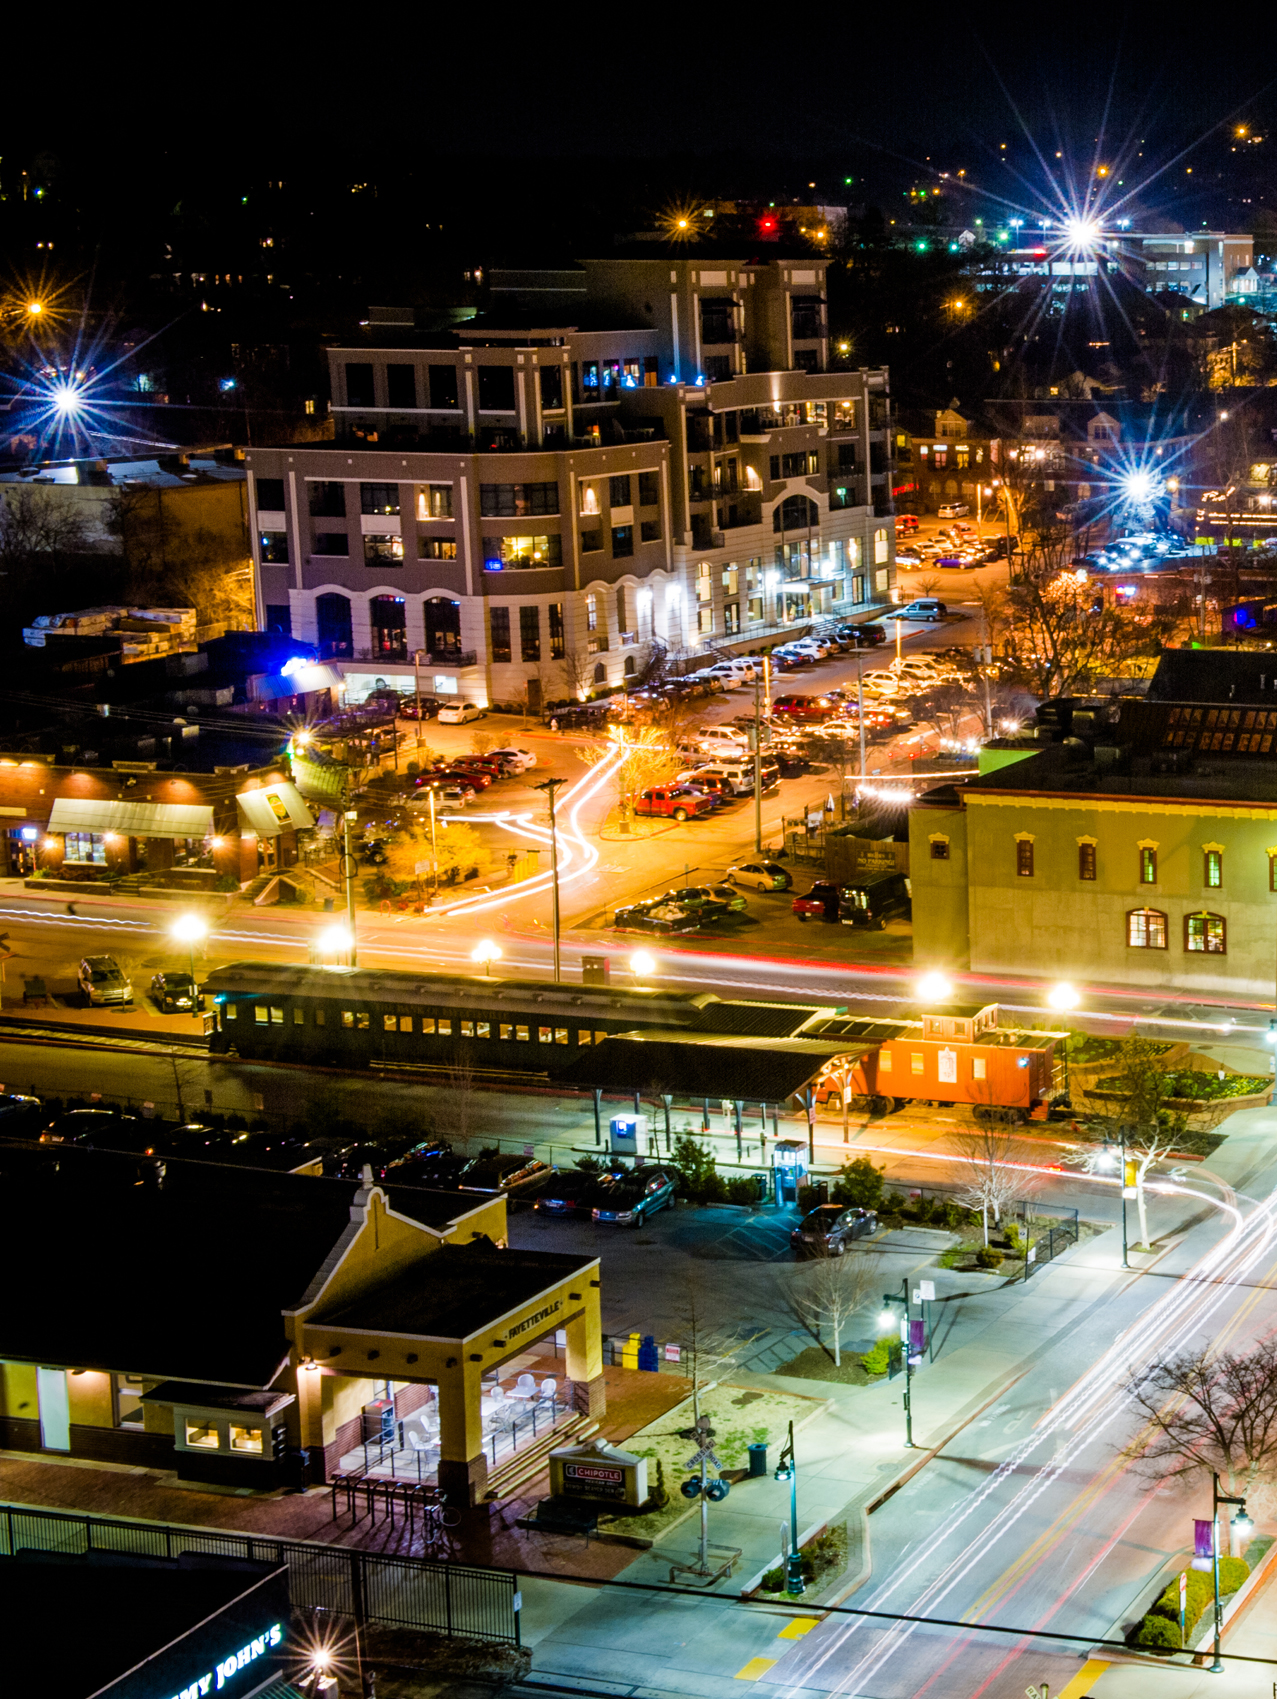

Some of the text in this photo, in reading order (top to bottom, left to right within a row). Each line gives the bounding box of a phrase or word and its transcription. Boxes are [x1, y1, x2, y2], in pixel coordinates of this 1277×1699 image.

[508, 1300, 560, 1340] FAYETTEVILLE
[686, 1440, 715, 1469] CROSSING
[578, 1468, 619, 1480] CHIPOTLE
[170, 1623, 282, 1699] MY JOHN'S
